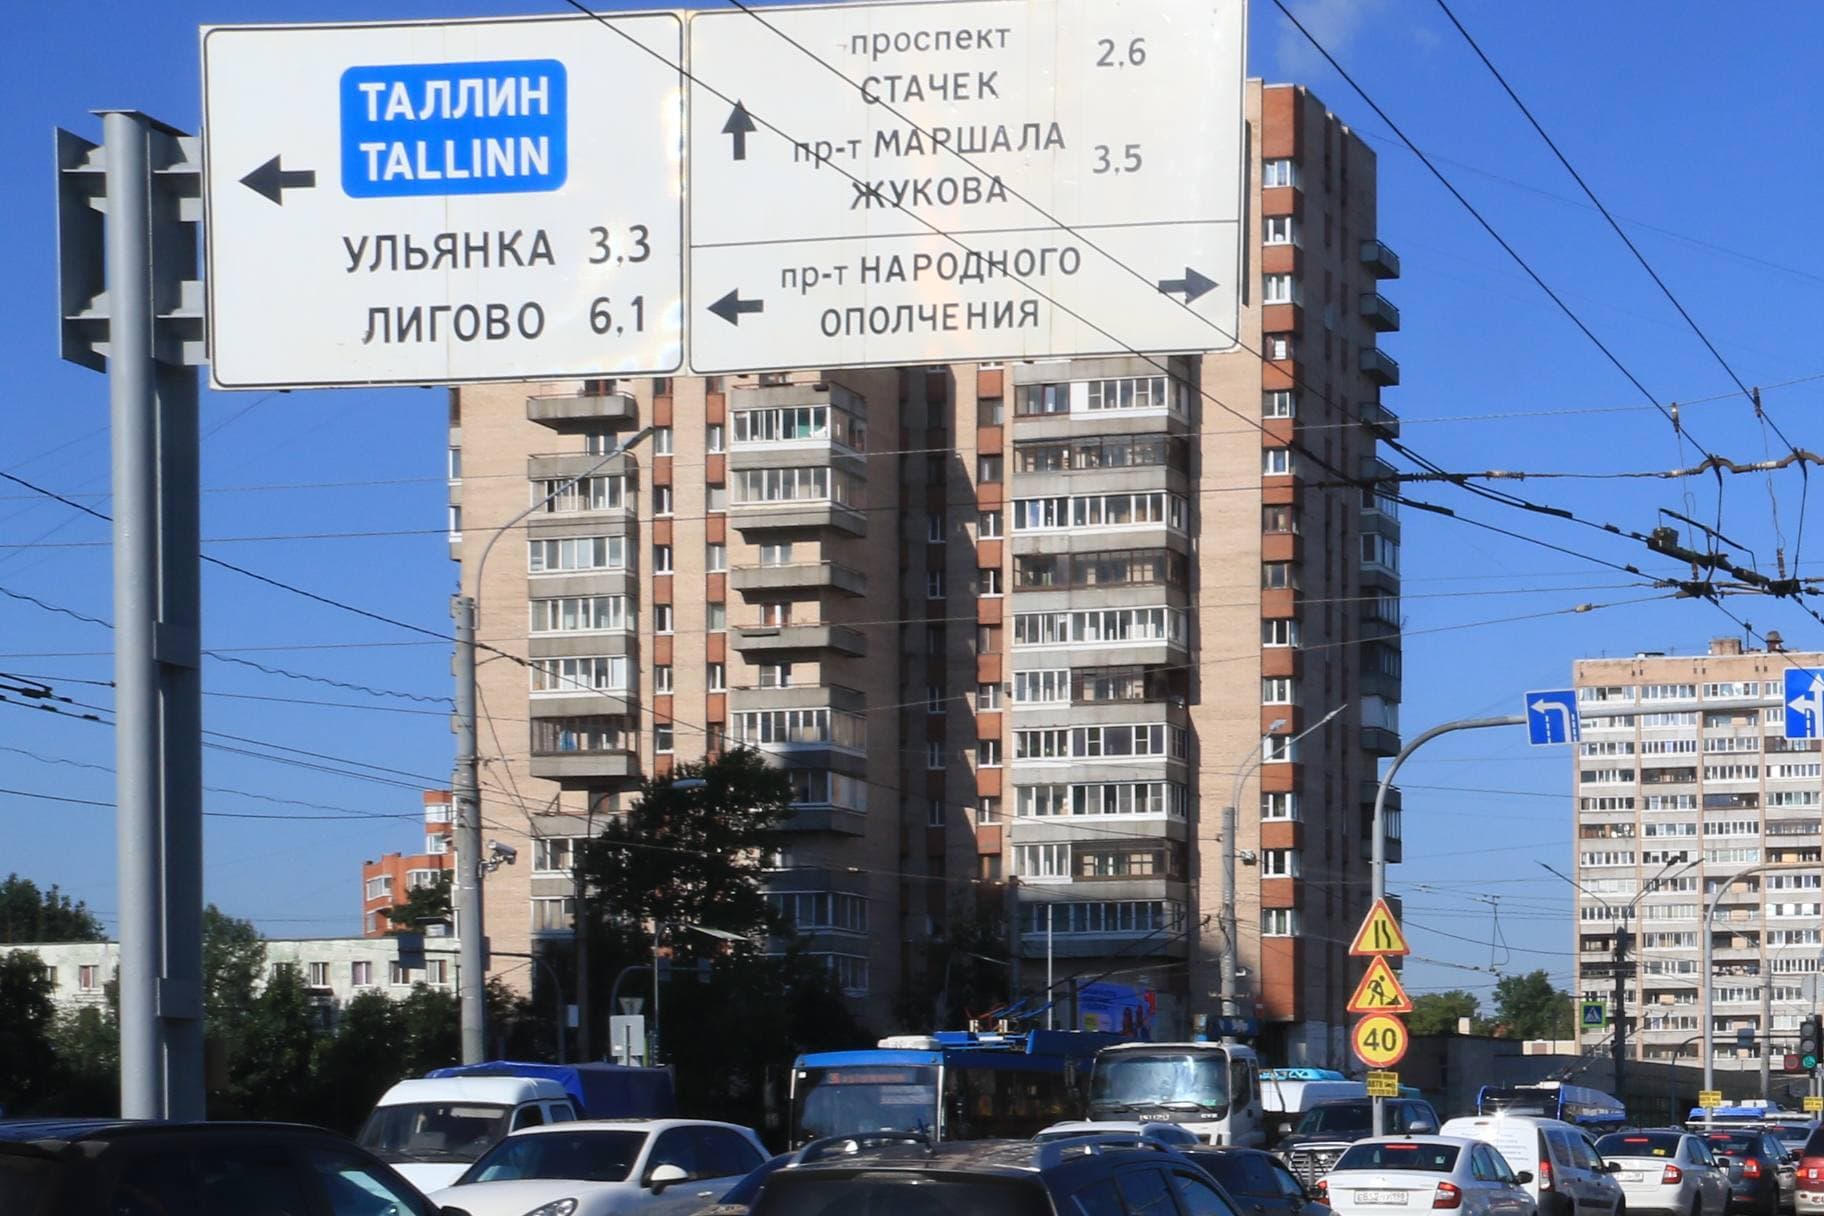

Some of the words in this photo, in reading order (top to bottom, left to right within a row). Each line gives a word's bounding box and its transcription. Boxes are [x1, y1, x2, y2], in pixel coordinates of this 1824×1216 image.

[850, 27, 1011, 61] проспект
[358, 76, 550, 122] ТАЛЛИН
[861, 71, 999, 105] СТАЧЕК
[359, 135, 550, 182] TALLINN
[793, 138, 863, 169] пр-т
[874, 121, 1067, 158] МАРШАЛА
[850, 176, 1008, 210] ЖУКОВА
[343, 229, 556, 273] УЛЬЯНКА
[780, 264, 850, 295] пр-т
[859, 246, 1082, 286] НАРОДНОГО
[363, 301, 545, 346] ЛИГОВО
[820, 300, 1040, 338] ОПОЛЧЕНИЯ
[1363, 1027, 1397, 1051] 40
